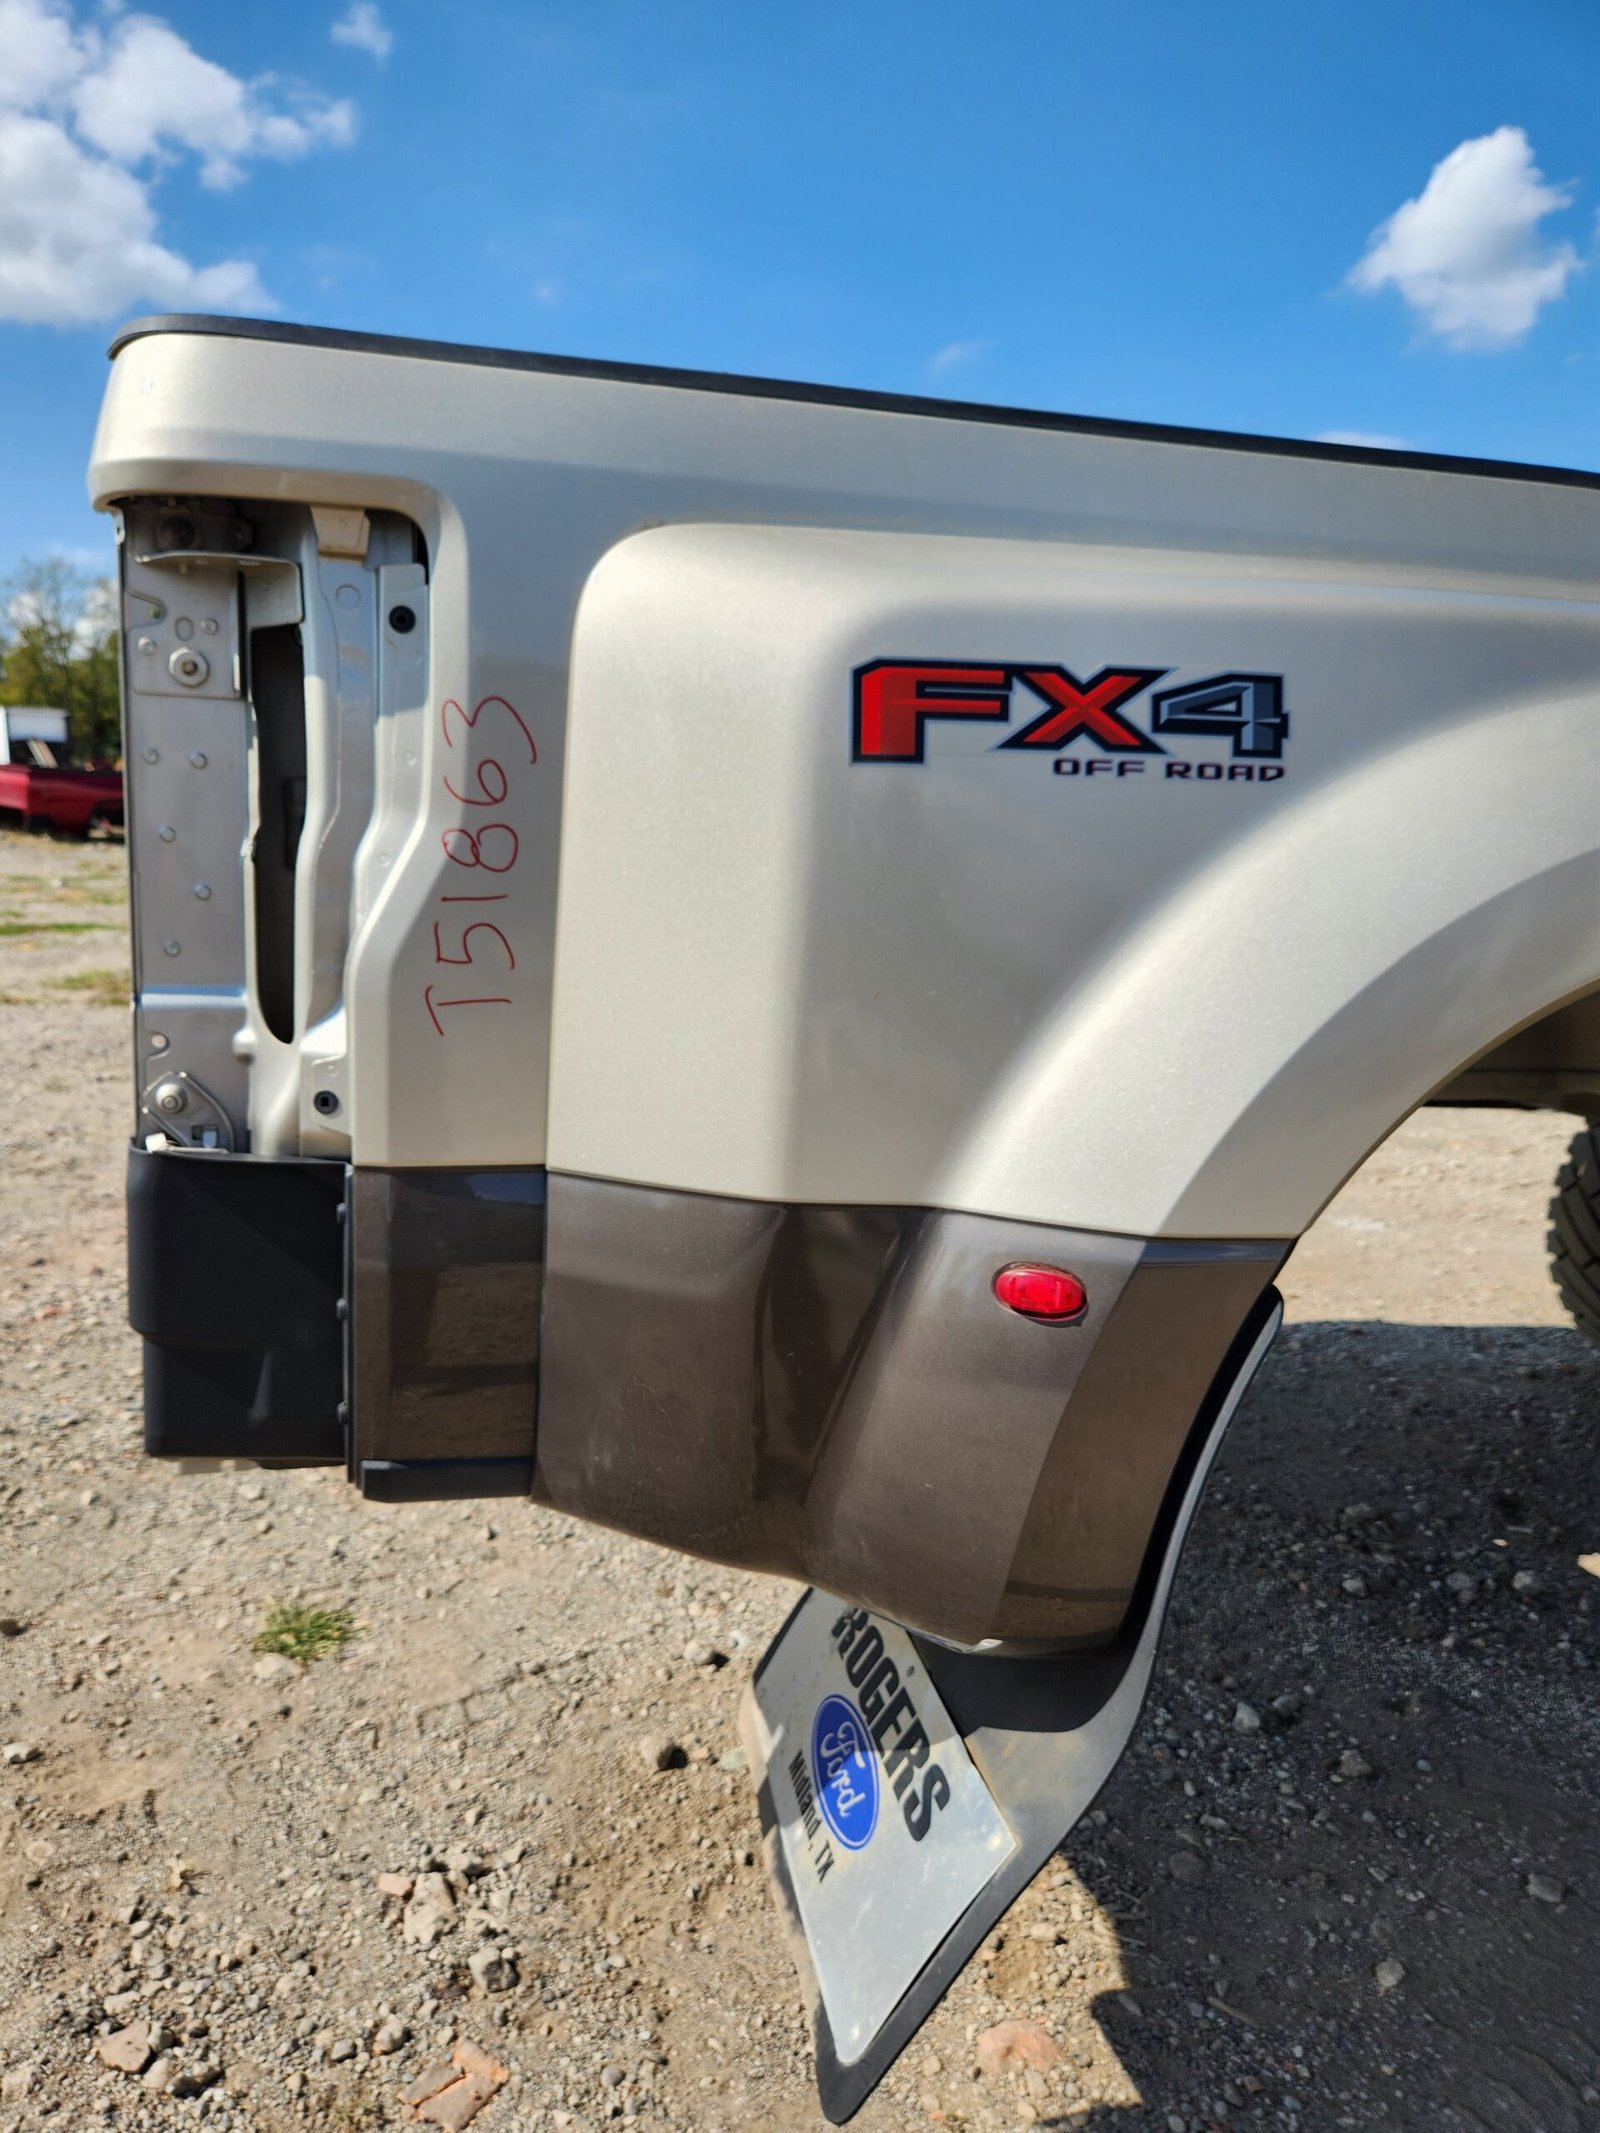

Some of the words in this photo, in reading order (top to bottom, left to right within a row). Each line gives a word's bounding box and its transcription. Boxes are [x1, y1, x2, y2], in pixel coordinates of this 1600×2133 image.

[852, 658, 1289, 764] FX4
[1053, 759, 1146, 778] OFF
[1165, 763, 1286, 782] ROAD
[424, 695, 537, 1037] T51863
[818, 1720, 868, 1819] Ford
[830, 1606, 951, 1842] ROGERS
[814, 1839, 835, 1883] TX
